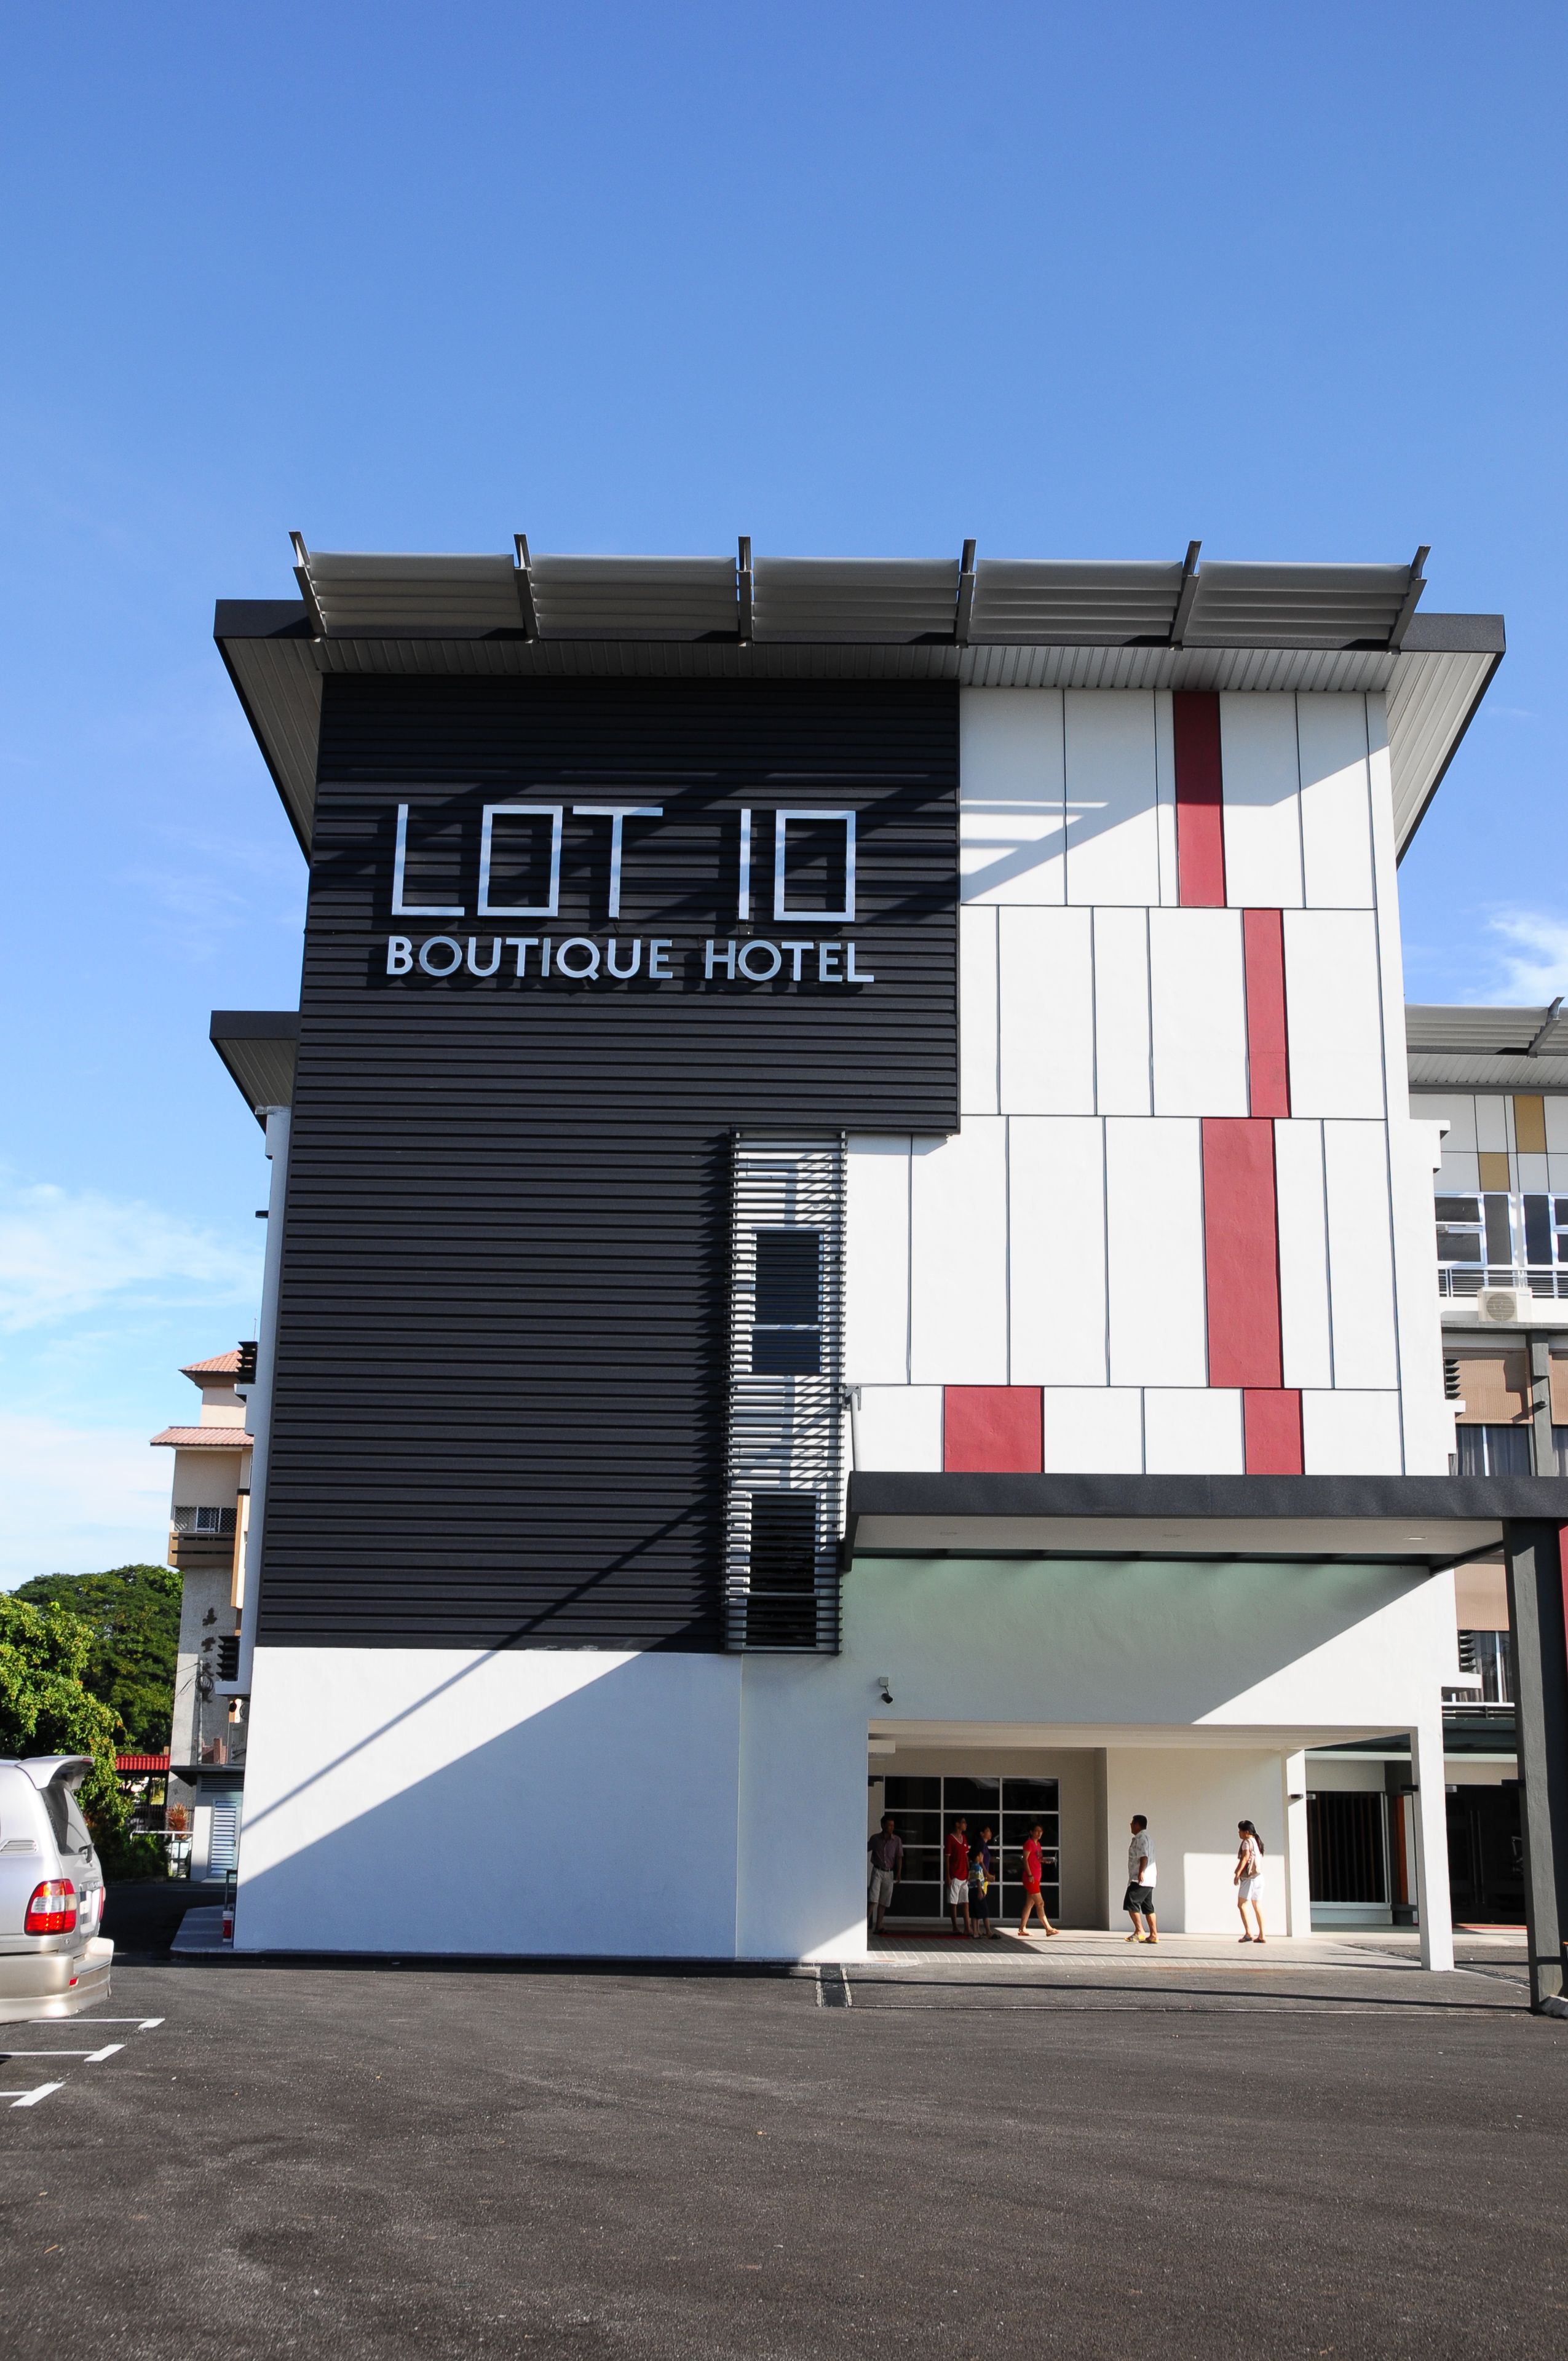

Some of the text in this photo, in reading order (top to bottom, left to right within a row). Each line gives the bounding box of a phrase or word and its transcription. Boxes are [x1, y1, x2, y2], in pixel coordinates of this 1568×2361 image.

[392, 804, 856, 922] LOT 10
[386, 935, 874, 983] BOUTIQUE HOTEL
